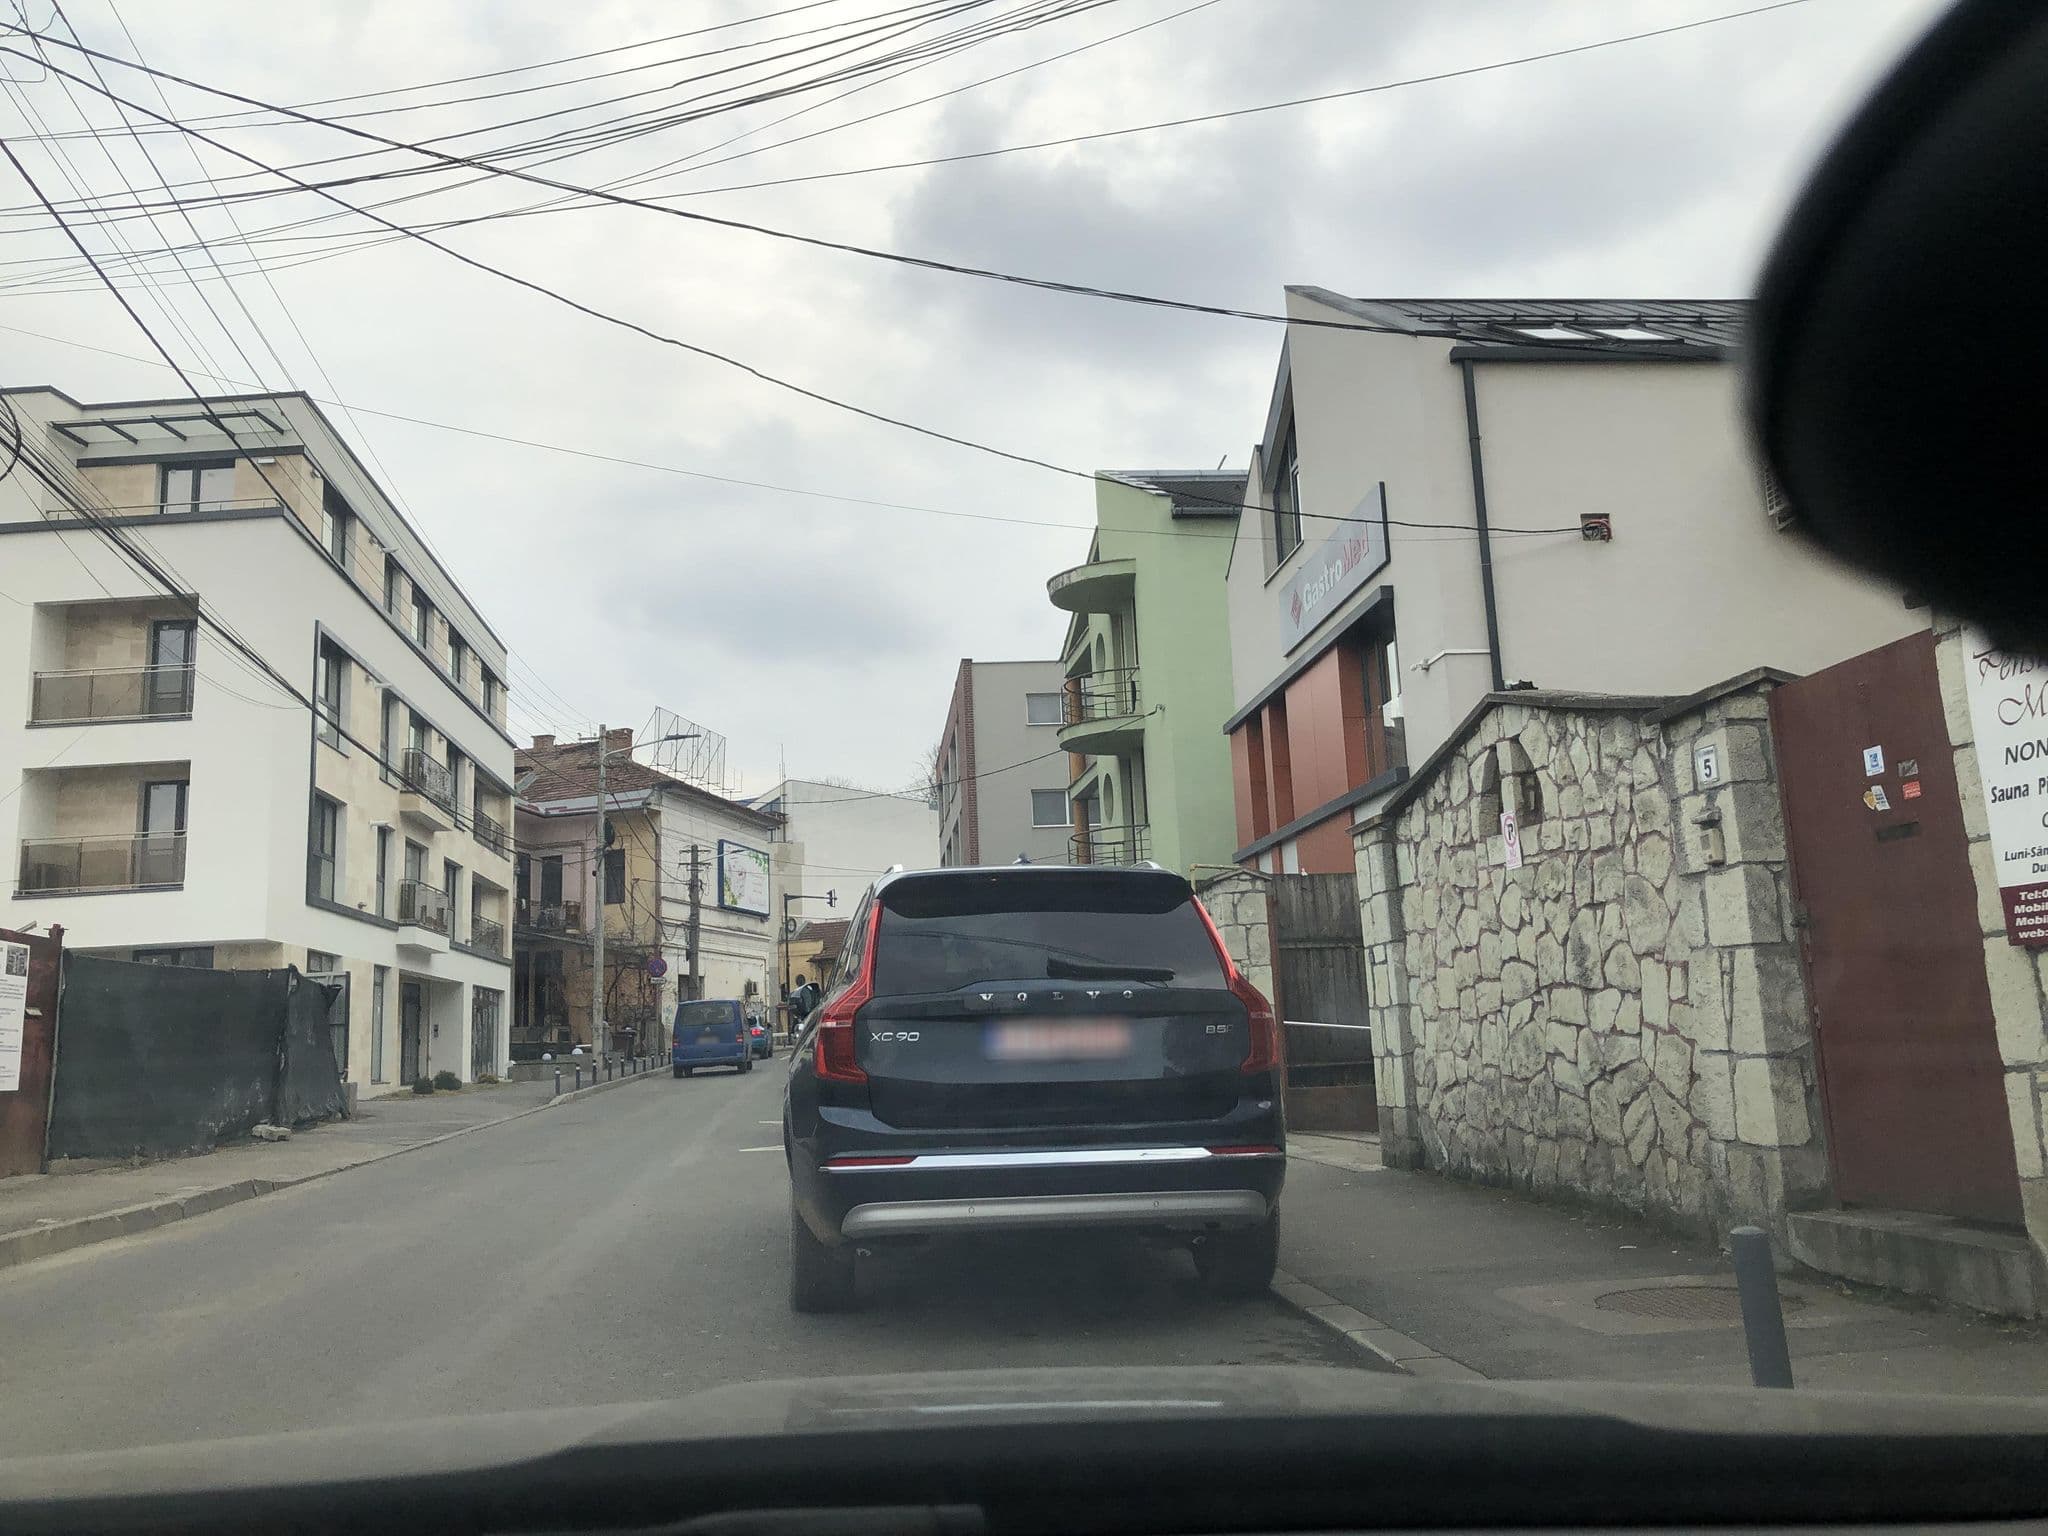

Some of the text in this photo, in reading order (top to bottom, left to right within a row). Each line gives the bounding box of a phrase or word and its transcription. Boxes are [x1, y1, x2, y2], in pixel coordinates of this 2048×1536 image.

[1704, 759, 1711, 778] 5
[1991, 784, 2029, 803] Sauna
[979, 990, 1133, 1001] VOLVO
